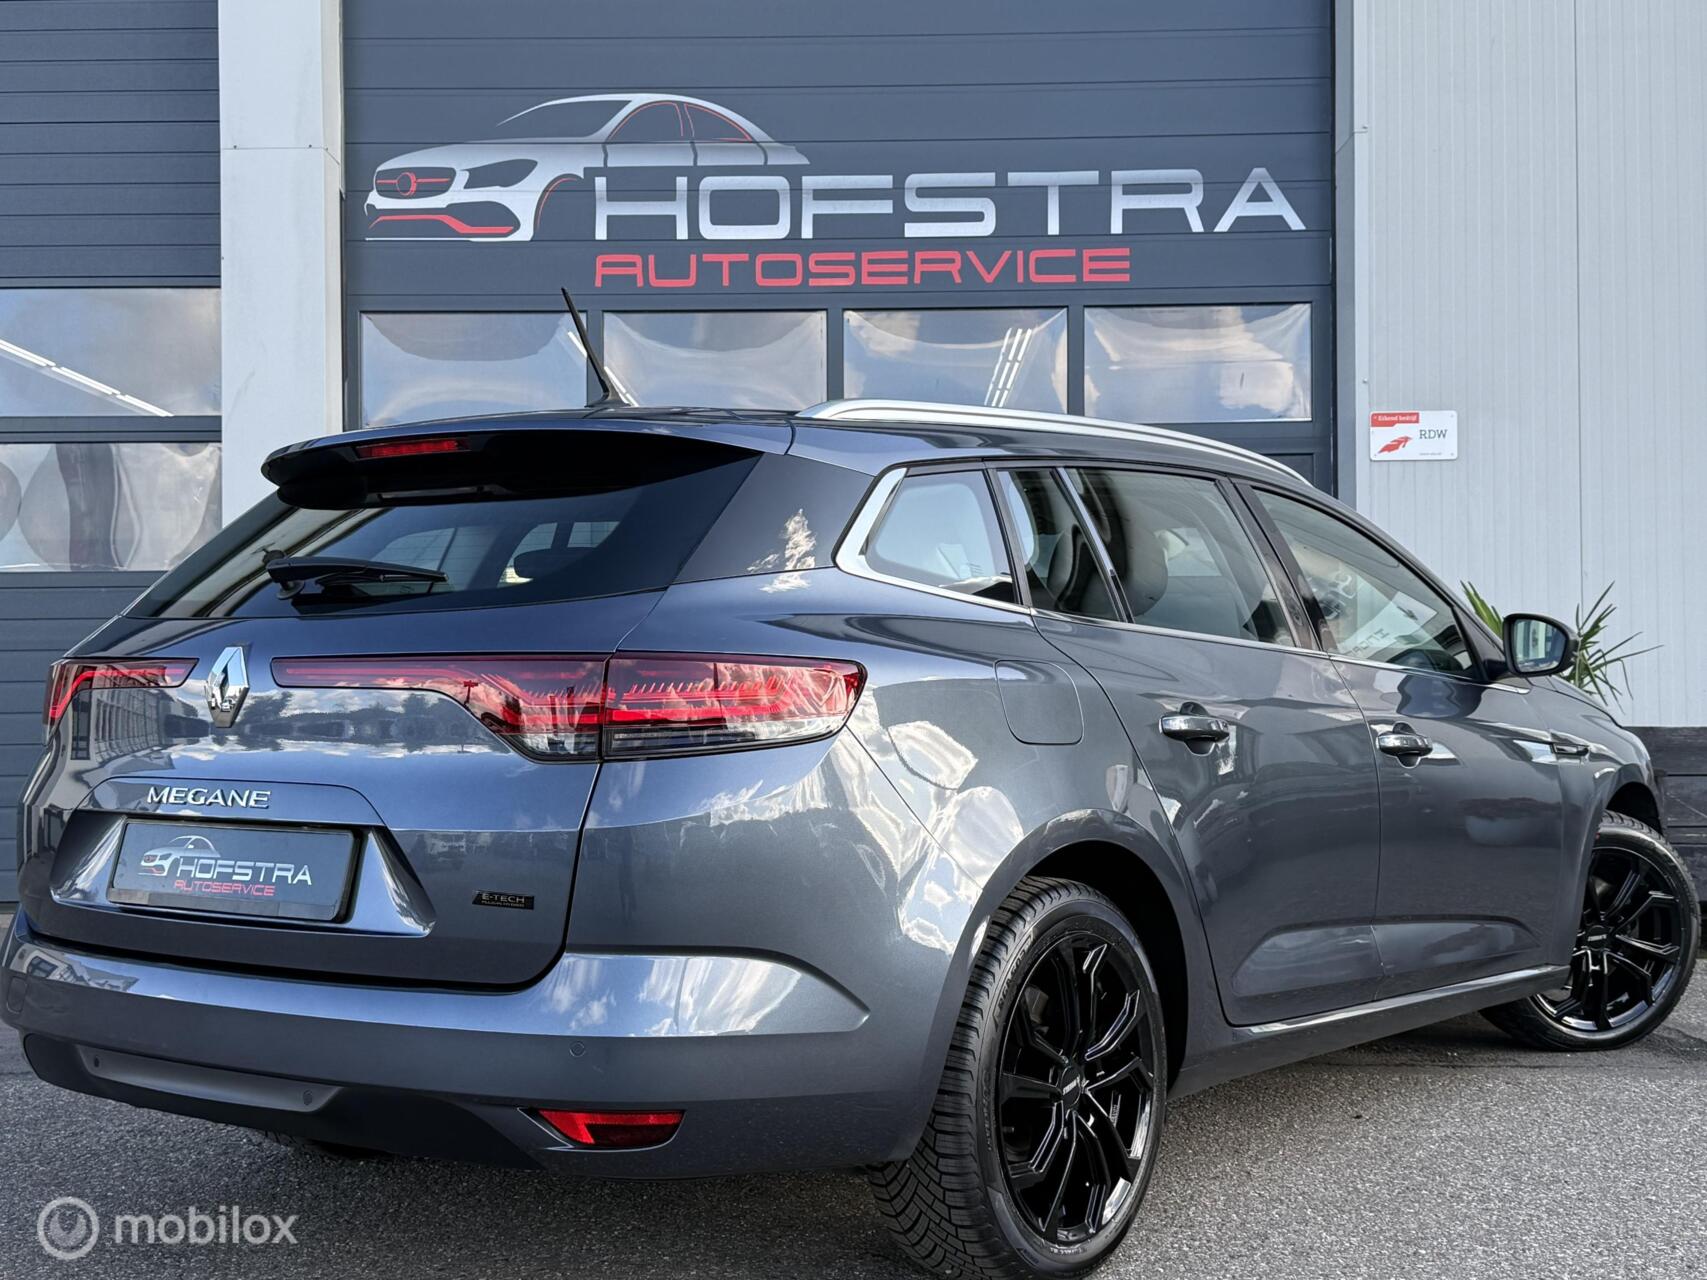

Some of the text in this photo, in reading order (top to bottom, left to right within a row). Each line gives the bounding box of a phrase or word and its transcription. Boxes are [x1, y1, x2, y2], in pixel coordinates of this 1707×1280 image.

[594, 167, 1307, 240] HOFSTRA
[594, 248, 1131, 288] AUTOSERVICE
[1418, 429, 1448, 440] RDW
[146, 786, 272, 809] MEGANE
[175, 856, 313, 886] HOFSTRA
[173, 879, 276, 897] AUTOSERVICE
[481, 893, 525, 904] E-TECH
